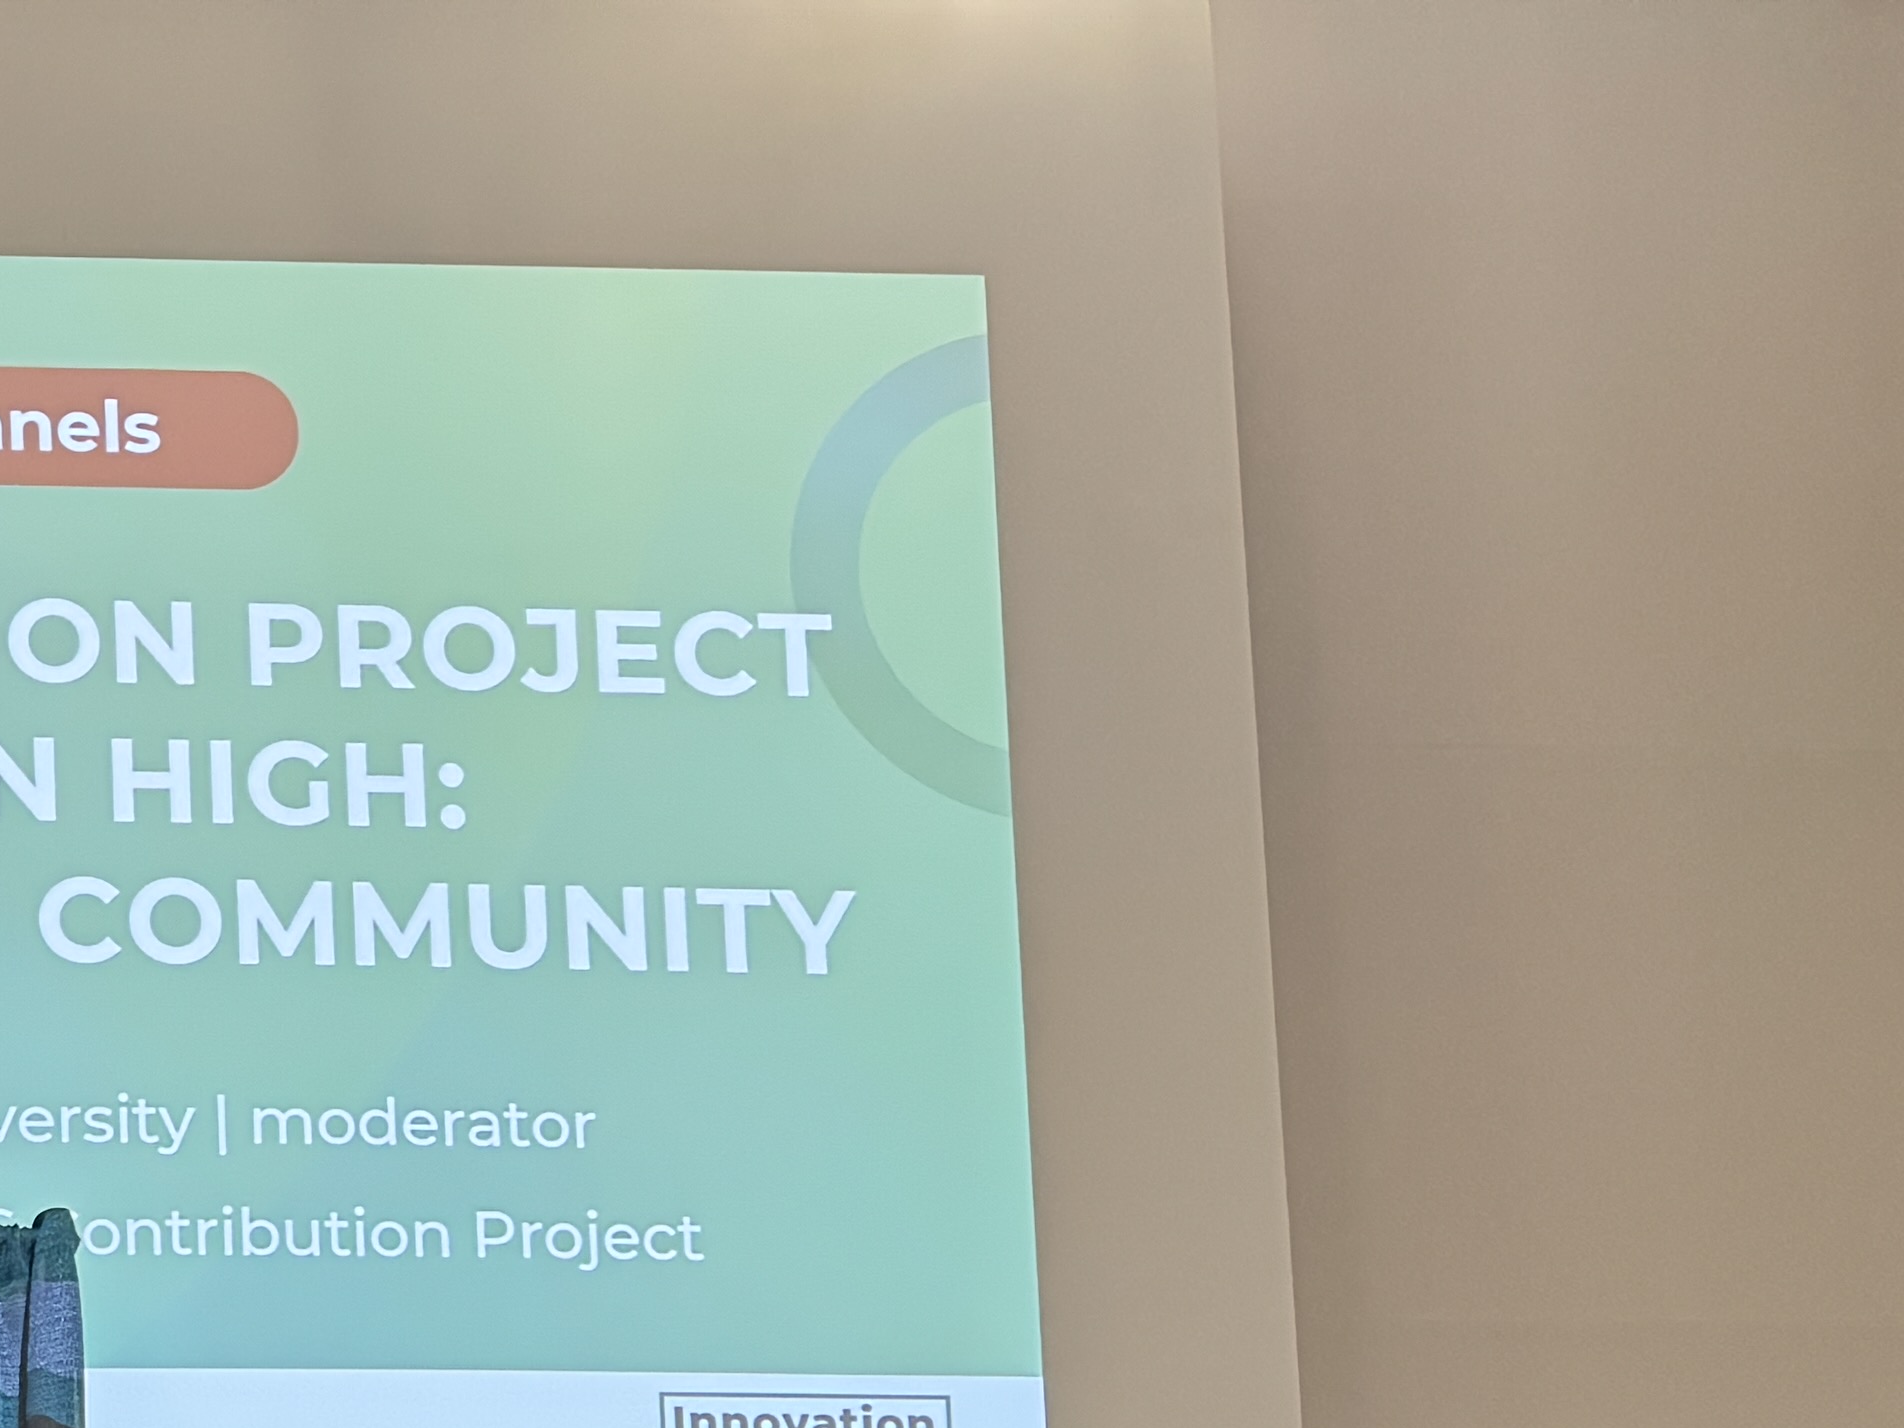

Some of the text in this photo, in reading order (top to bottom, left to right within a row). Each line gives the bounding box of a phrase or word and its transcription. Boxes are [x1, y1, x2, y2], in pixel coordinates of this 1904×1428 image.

[249, 603, 832, 696] PROJECT
[112, 739, 465, 829] HIGH:
[39, 877, 856, 974] COMMUNITY
[254, 1097, 595, 1148] moderator
[70, 1206, 449, 1257] ontribution
[477, 1210, 704, 1270] Project
